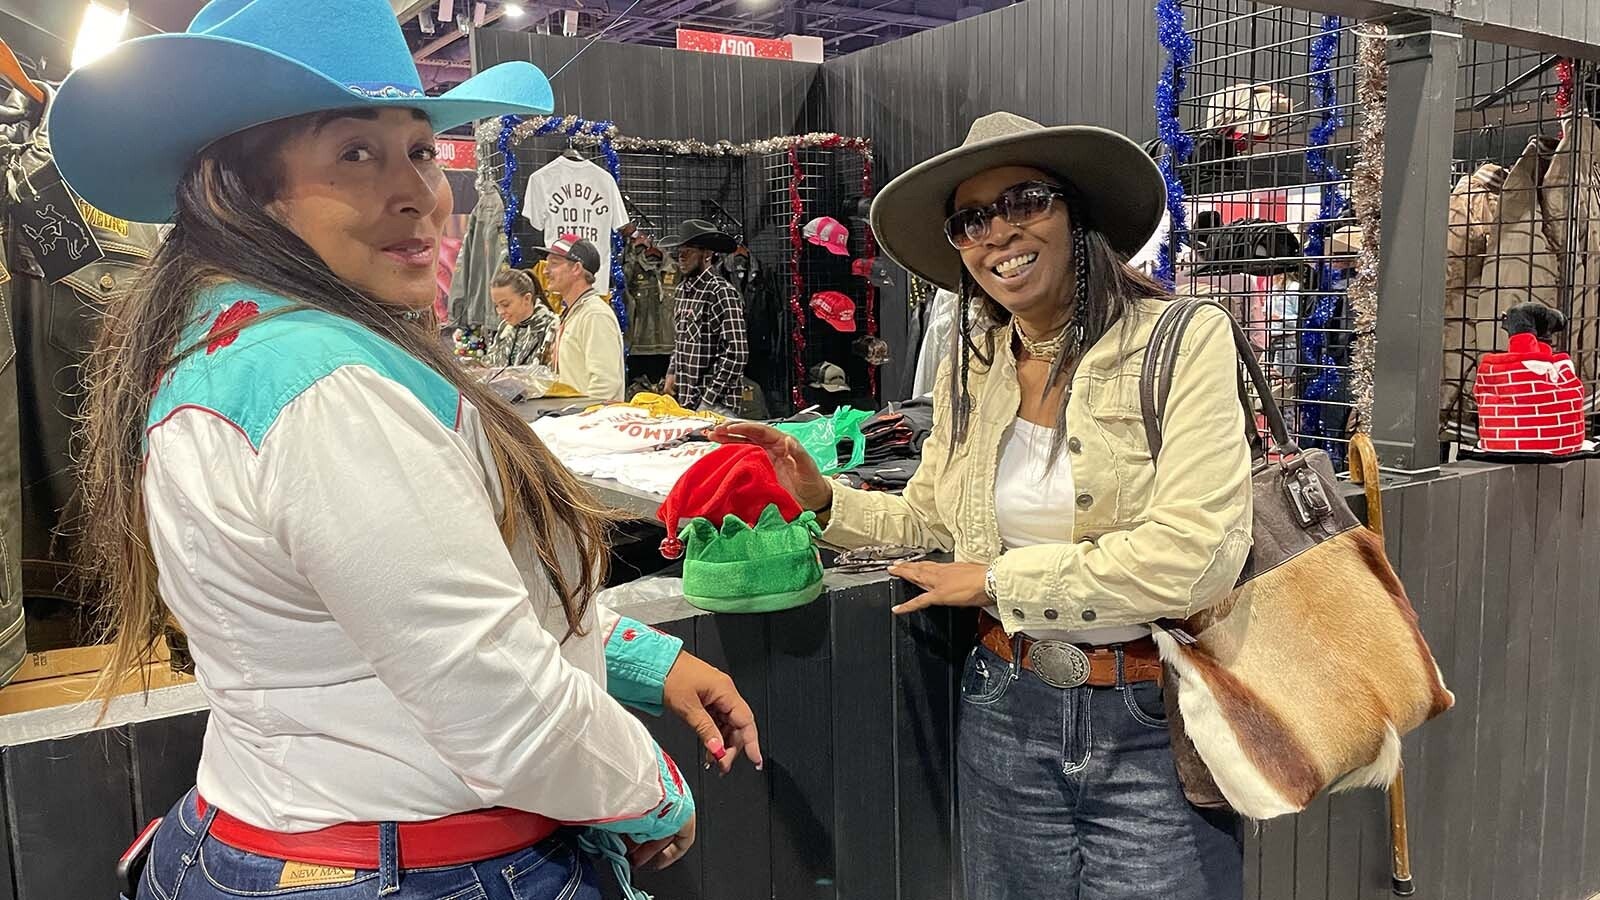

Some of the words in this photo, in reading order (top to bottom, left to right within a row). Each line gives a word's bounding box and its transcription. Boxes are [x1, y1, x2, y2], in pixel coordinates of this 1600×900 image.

[548, 183, 609, 215] COWBOYS
[562, 207, 578, 222] DO
[583, 208, 592, 223] IT
[289, 868, 318, 880] NEW
[319, 866, 346, 877] MAX
